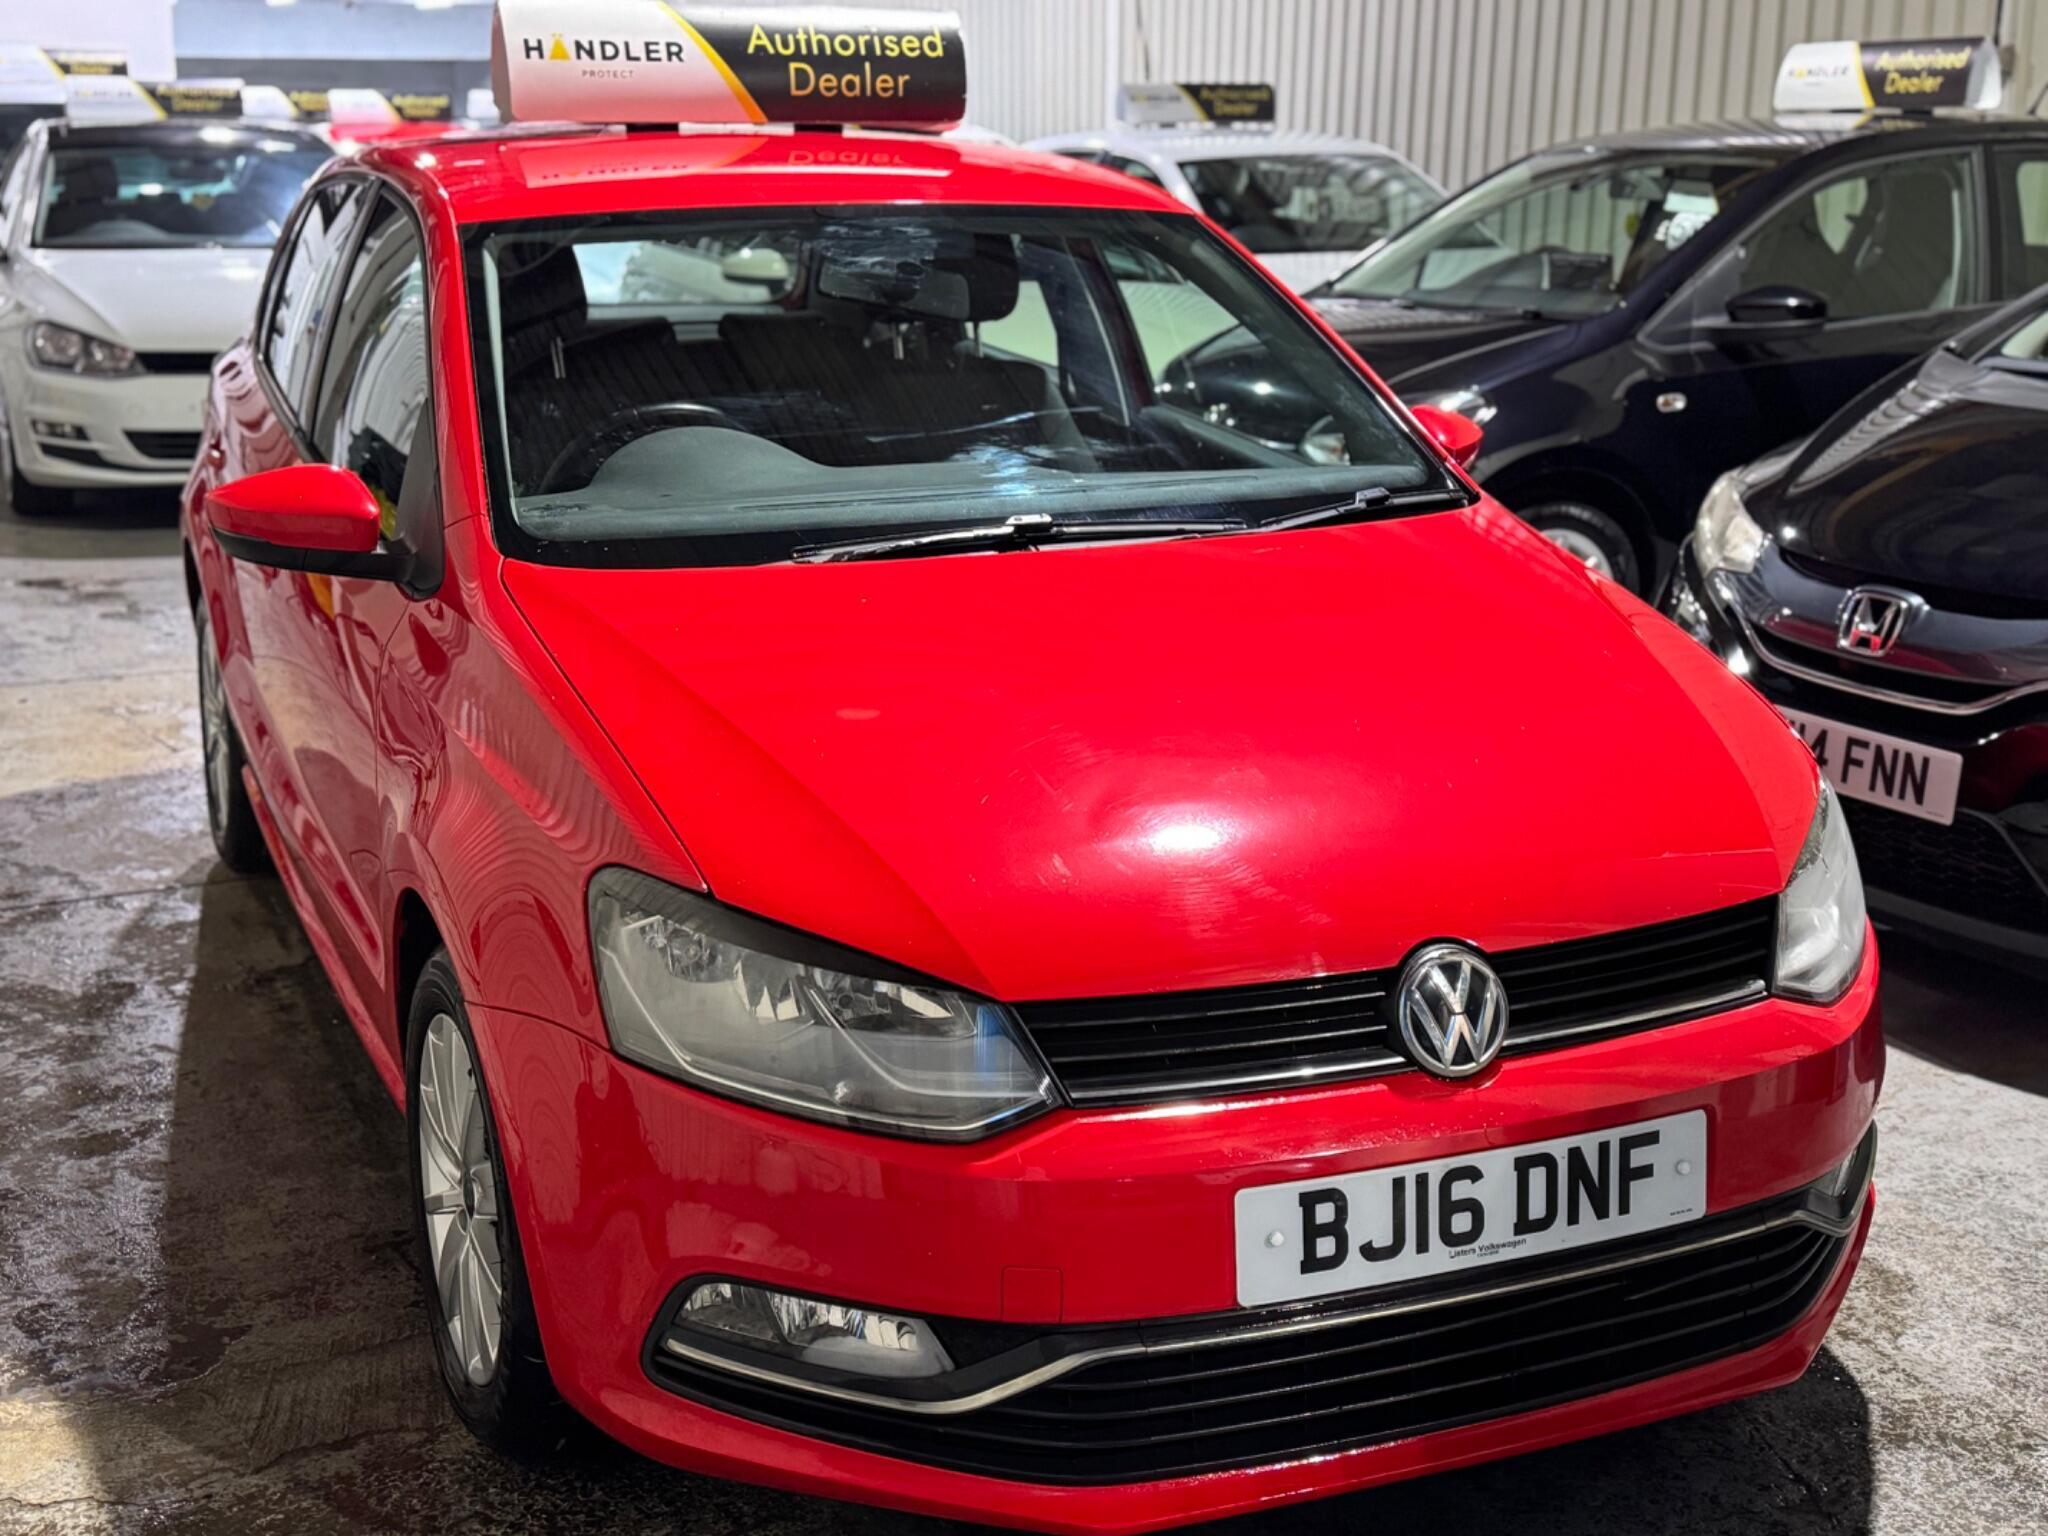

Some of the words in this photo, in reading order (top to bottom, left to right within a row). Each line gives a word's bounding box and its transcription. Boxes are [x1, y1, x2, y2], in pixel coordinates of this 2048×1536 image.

[747, 24, 944, 57] Authorised
[582, 70, 634, 79] PROTECT
[788, 61, 911, 97] Dealer
[1840, 736, 1930, 806] FNN
[1298, 1165, 1485, 1275] BJ16
[1513, 1130, 1660, 1236] DNF
[1478, 1238, 1527, 1252] Volkswagen
